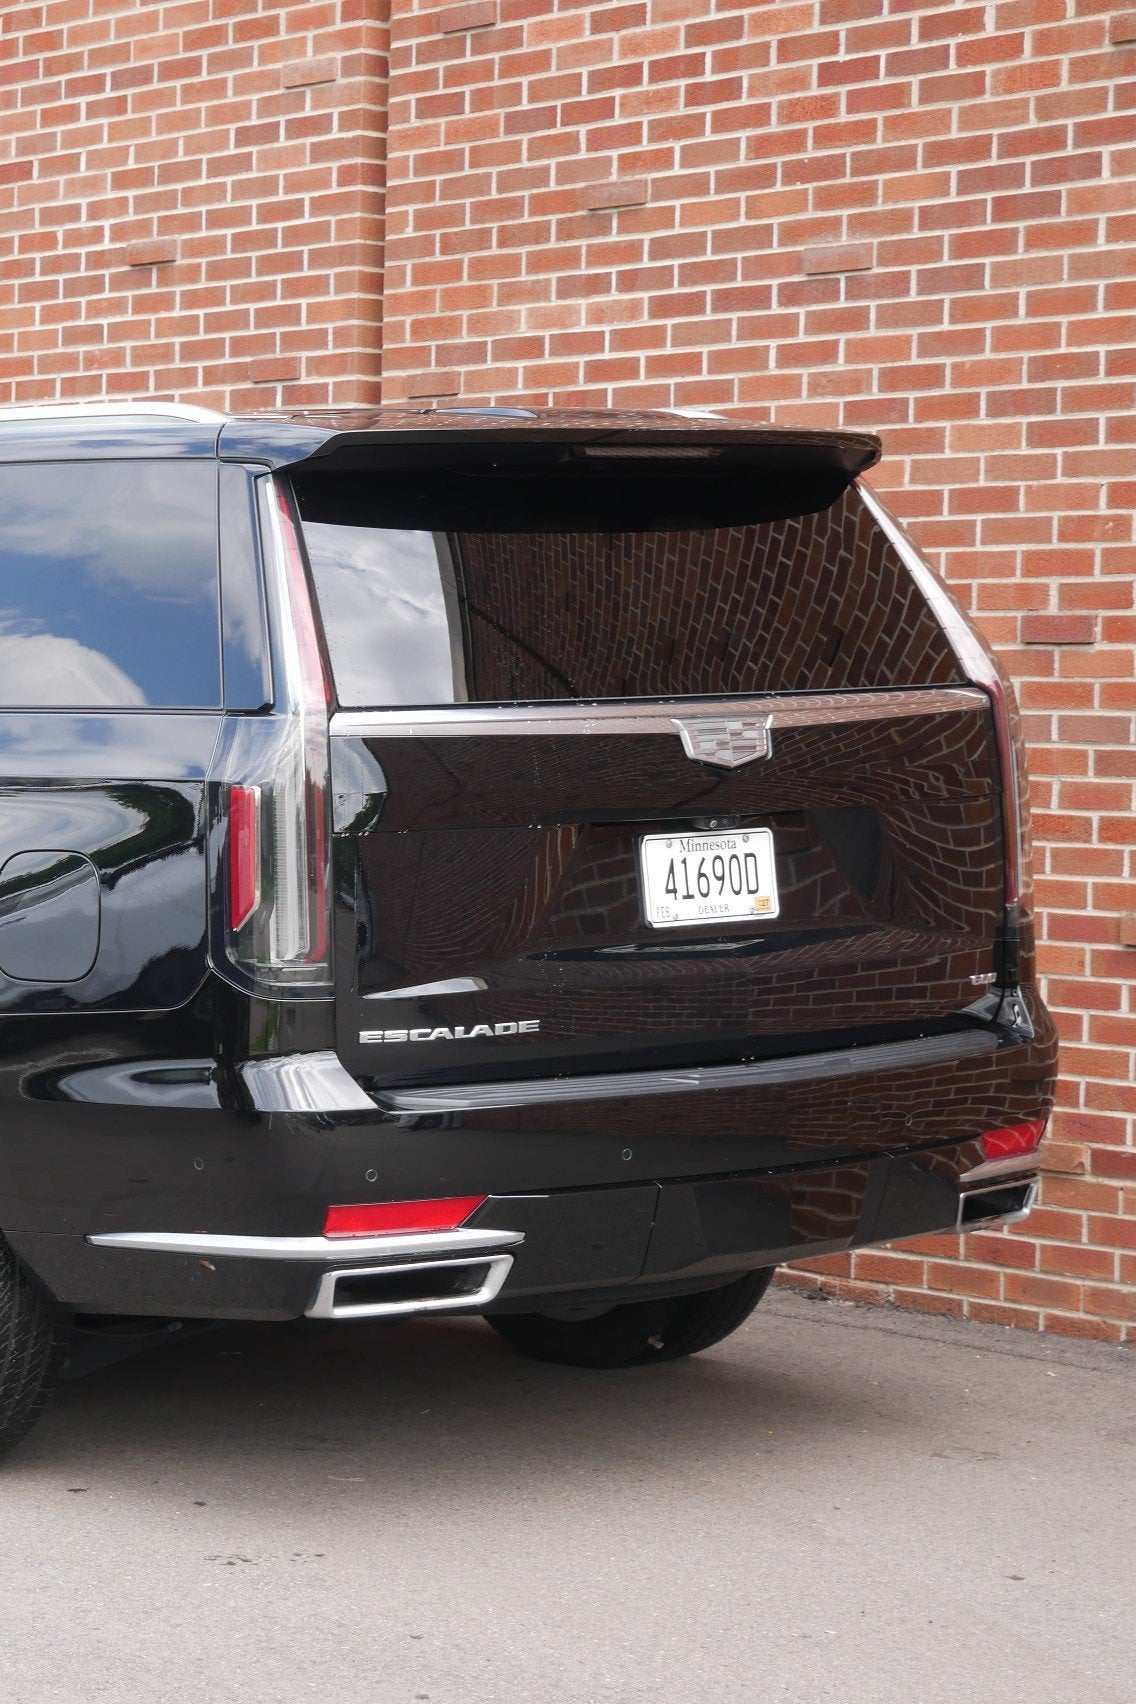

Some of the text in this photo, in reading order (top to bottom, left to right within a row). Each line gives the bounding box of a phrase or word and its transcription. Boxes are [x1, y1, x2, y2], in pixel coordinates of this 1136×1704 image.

[680, 839, 737, 853] Minnesota
[665, 852, 759, 900] 41690D
[698, 903, 730, 914] DEALER
[359, 1020, 540, 1044] ESCALADE
